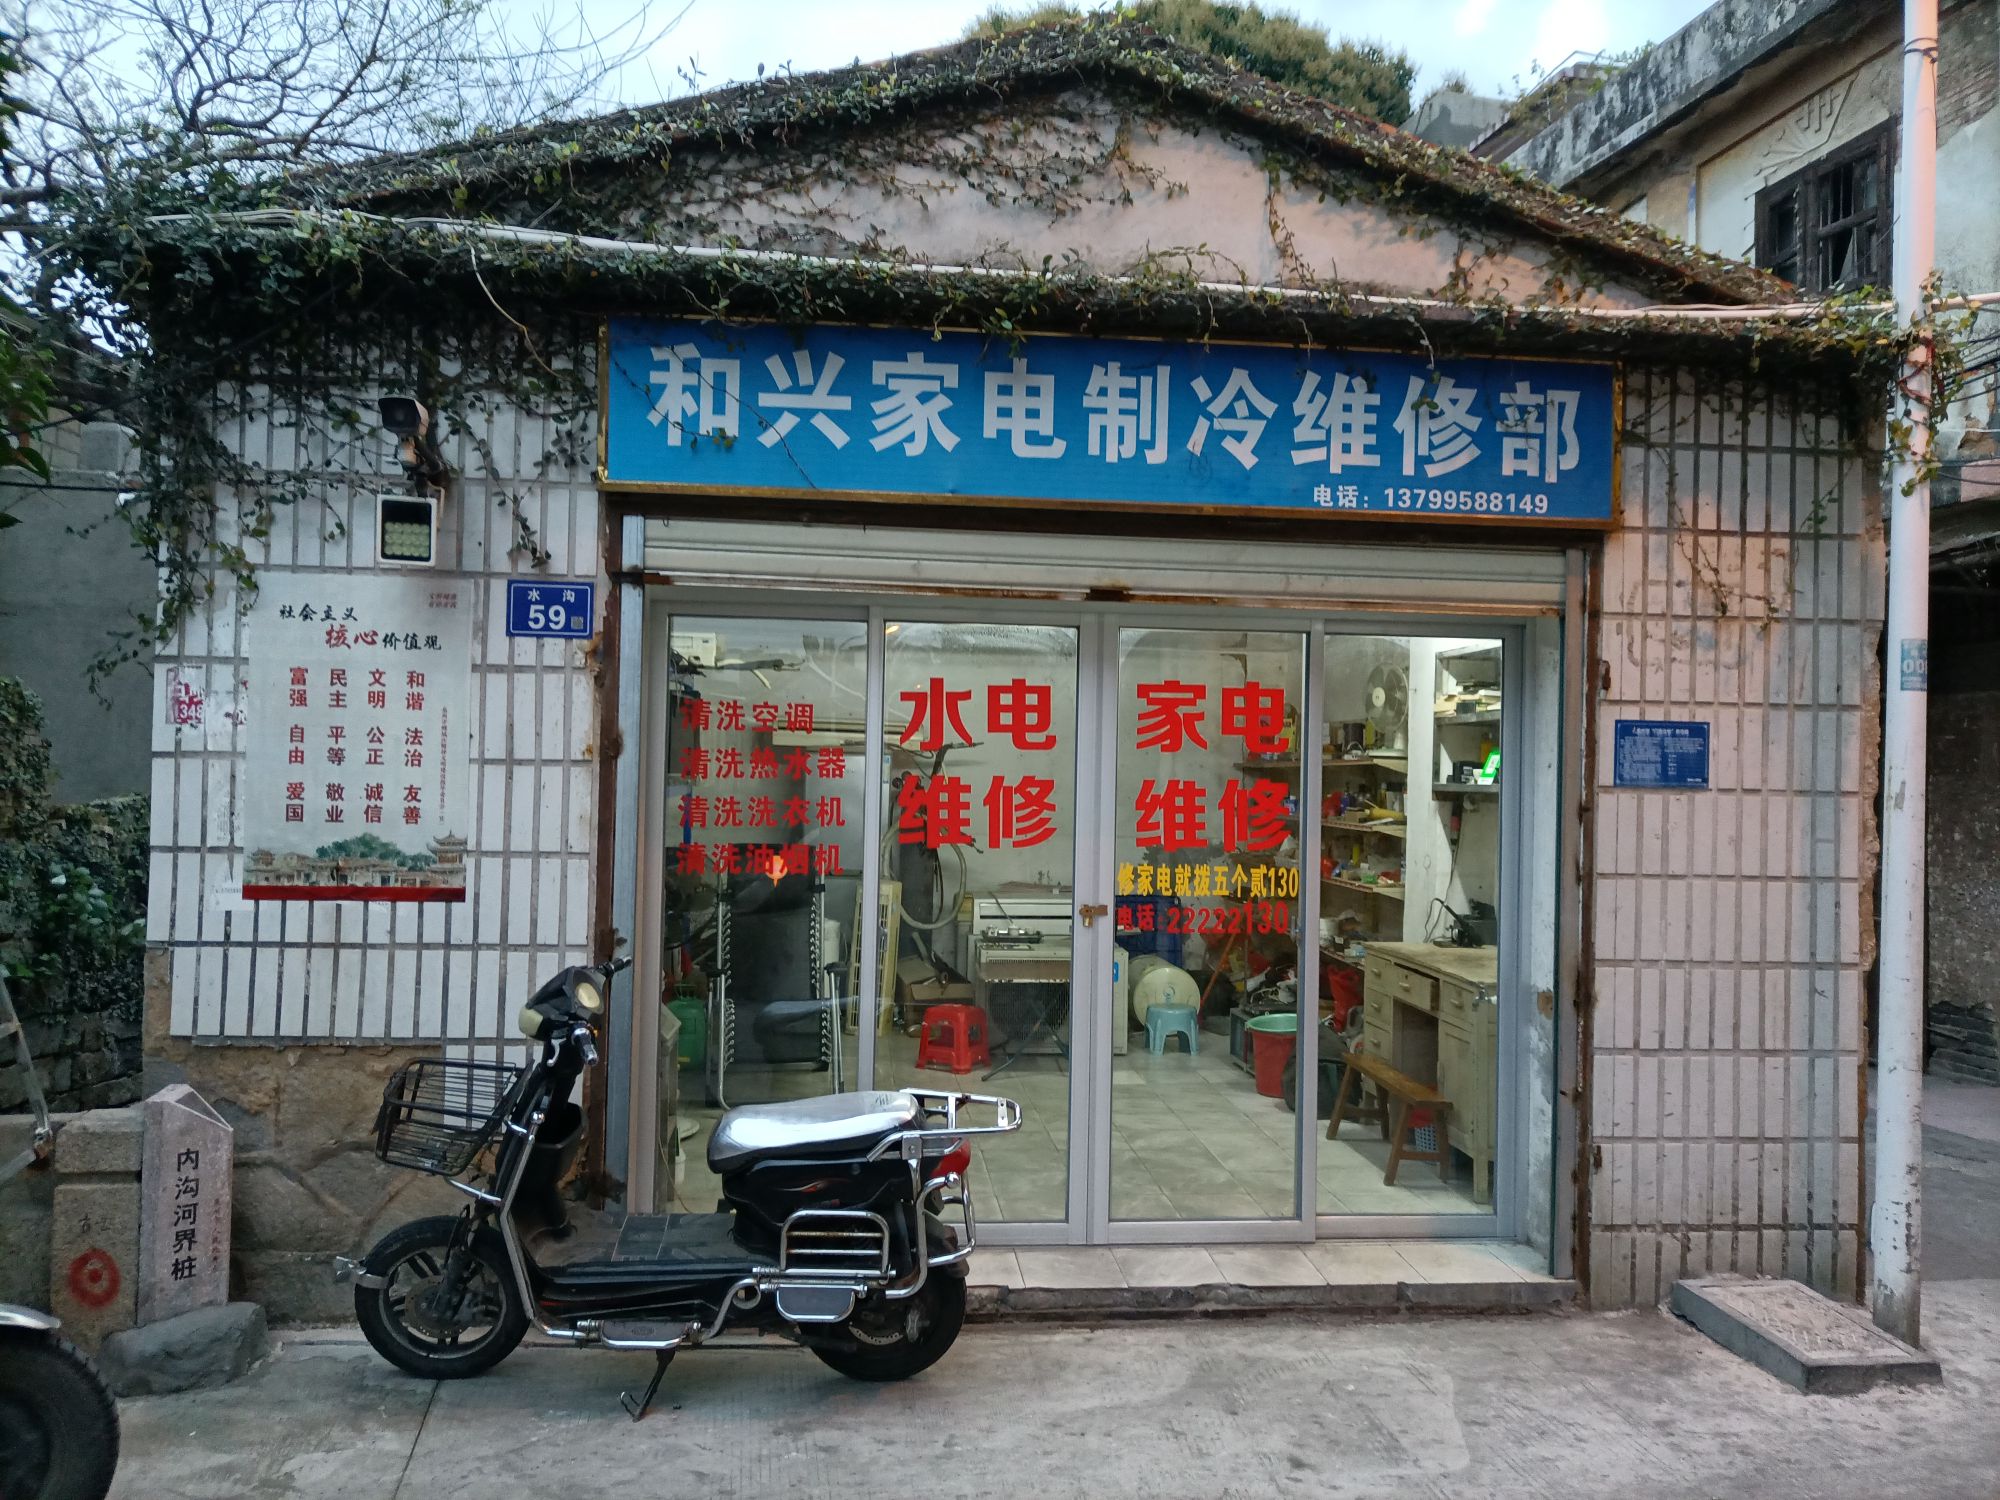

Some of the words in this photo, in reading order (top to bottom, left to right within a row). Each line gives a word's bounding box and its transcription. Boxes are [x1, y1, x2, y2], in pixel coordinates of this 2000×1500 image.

[646, 343, 1581, 483] 和兴家电制冷维修部
[279, 603, 359, 622] 社会主义
[528, 604, 567, 630] 59
[325, 624, 442, 651] 核心价值观
[289, 667, 308, 707] 富强
[328, 668, 347, 709] 民主
[368, 668, 386, 708] 文明
[405, 670, 425, 710] 和谐
[679, 698, 814, 735] 清洗空调
[900, 677, 1057, 751] 水电
[1137, 680, 1289, 753] 家电
[289, 725, 305, 764] 自由
[327, 726, 346, 765] 平等
[366, 727, 385, 766] 公正
[404, 728, 423, 768] 法治
[679, 746, 846, 780] 清洗热水器
[285, 782, 305, 822] 爱国
[325, 782, 345, 823] 敬业
[364, 783, 383, 824] 诚信
[403, 785, 422, 825] 友善
[677, 794, 846, 829] 清洗洗衣机
[898, 775, 1057, 849] 维修
[1135, 779, 1292, 853] 维修
[675, 841, 844, 876] 清洗油烟机
[1117, 863, 1299, 898] 修家电就拨五个贰130
[171, 1148, 200, 1281] 内沟河界桩
